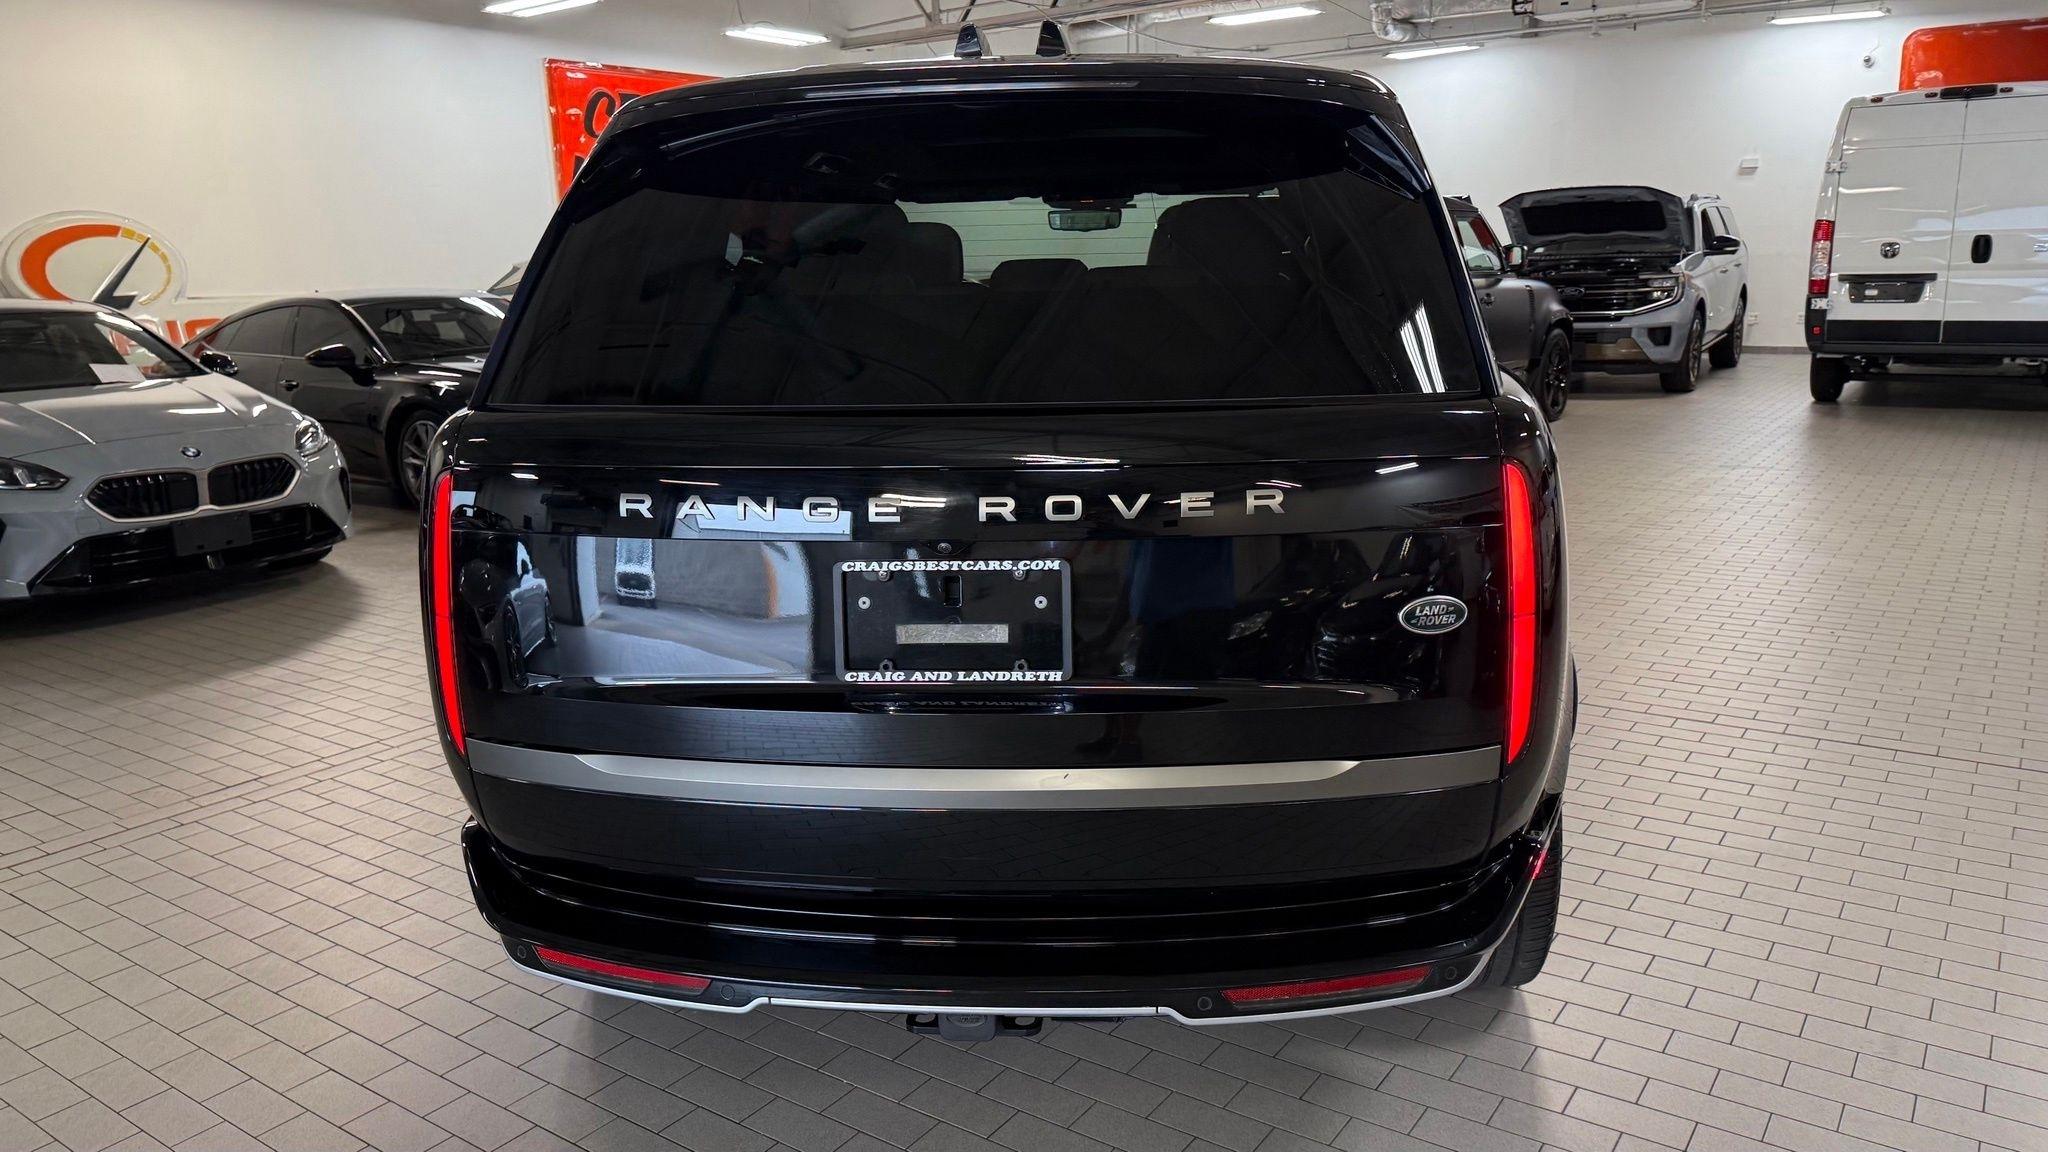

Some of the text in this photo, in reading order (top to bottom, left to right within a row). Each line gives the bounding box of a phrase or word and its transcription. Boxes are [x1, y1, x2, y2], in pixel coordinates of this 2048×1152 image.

[618, 489, 1286, 523] RANGE ROVER
[841, 560, 1061, 572] CRAIGSBESTCARS.COM
[1415, 604, 1447, 616] LAND
[1417, 614, 1457, 626] ROVER
[844, 671, 1063, 682] CRAIG AND LANDRETH
